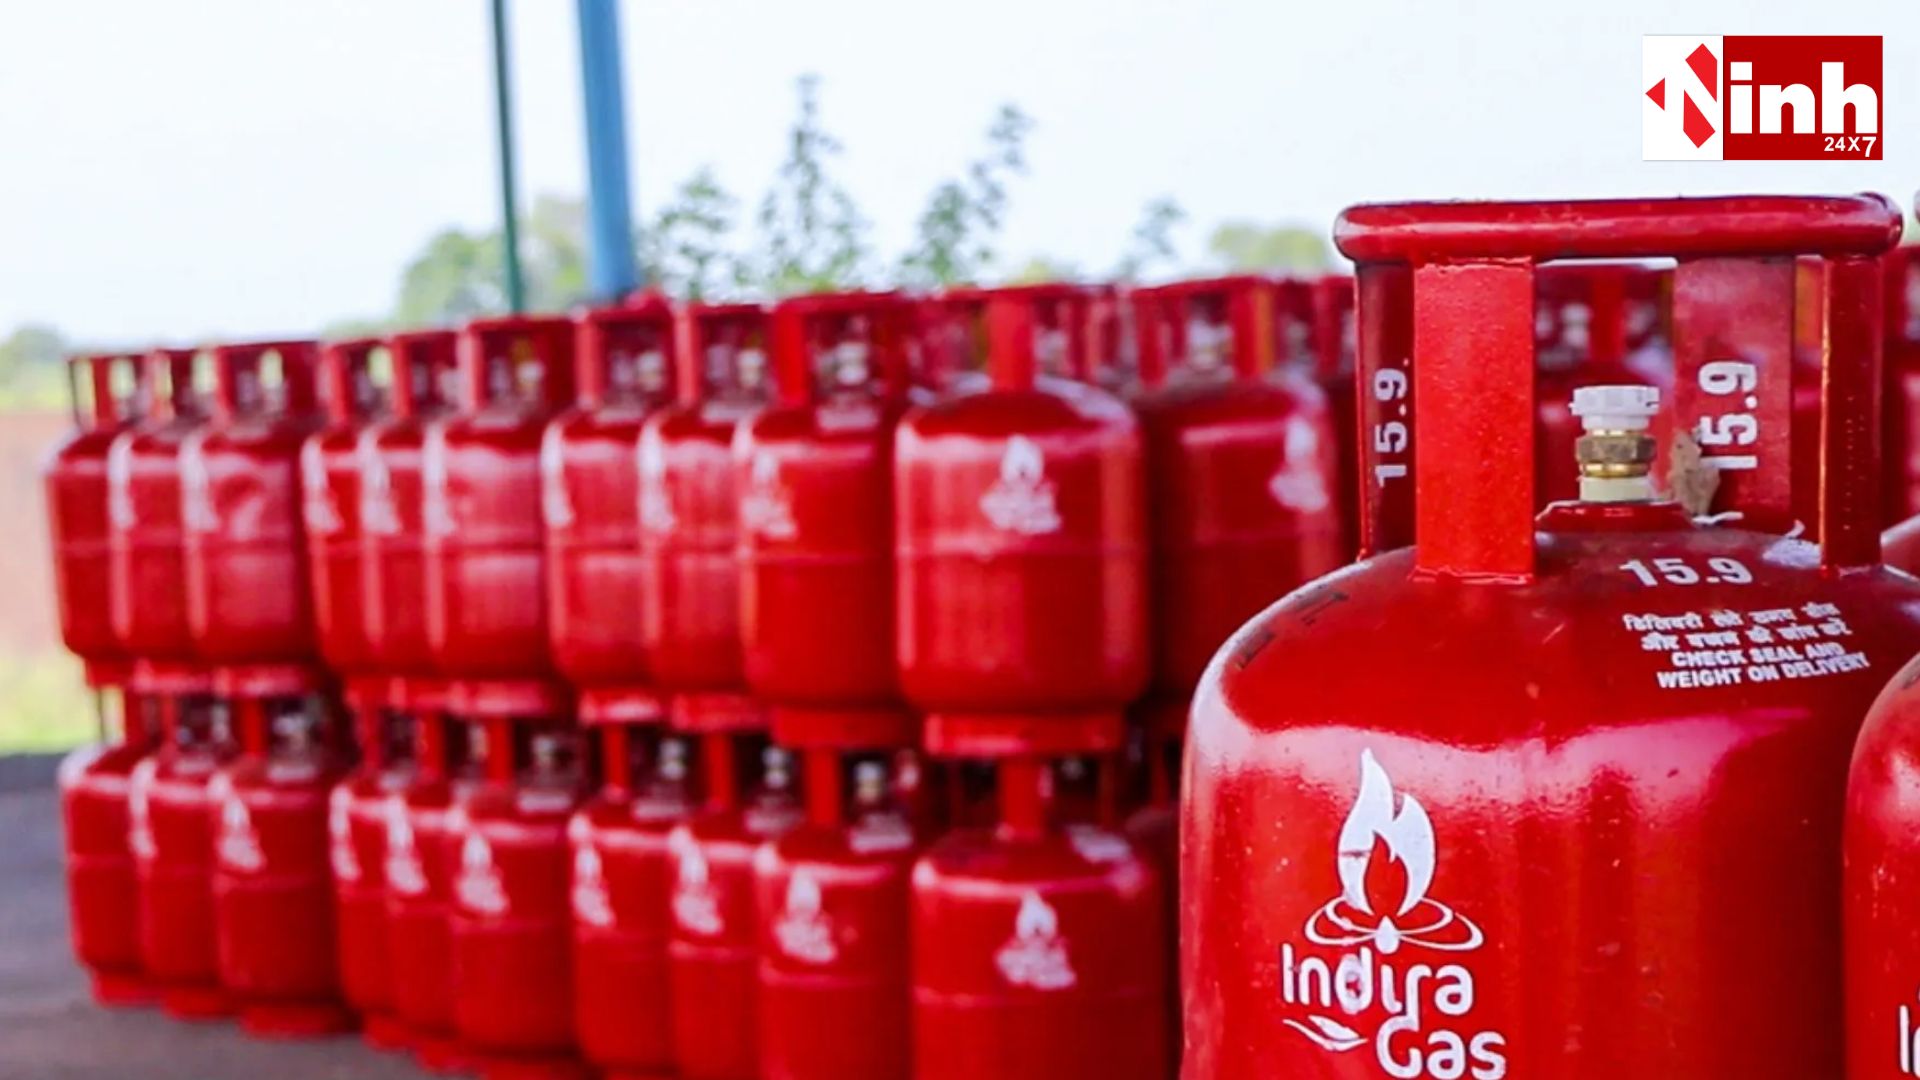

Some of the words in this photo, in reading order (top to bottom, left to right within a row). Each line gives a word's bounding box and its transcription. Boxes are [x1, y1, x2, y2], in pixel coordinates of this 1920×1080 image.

[1697, 361, 1758, 469] 15.9
[1619, 557, 1753, 586] 15.9
[1657, 669, 1742, 688] WEIGHT
[1748, 665, 1780, 682] ON
[1781, 652, 1870, 678] DELIVERY
[1671, 649, 1748, 667] CHECK
[1749, 645, 1804, 663] SEAL
[1805, 642, 1846, 658] AND
[1281, 943, 1474, 1025] Indira
[1376, 1016, 1507, 1080] Gas
